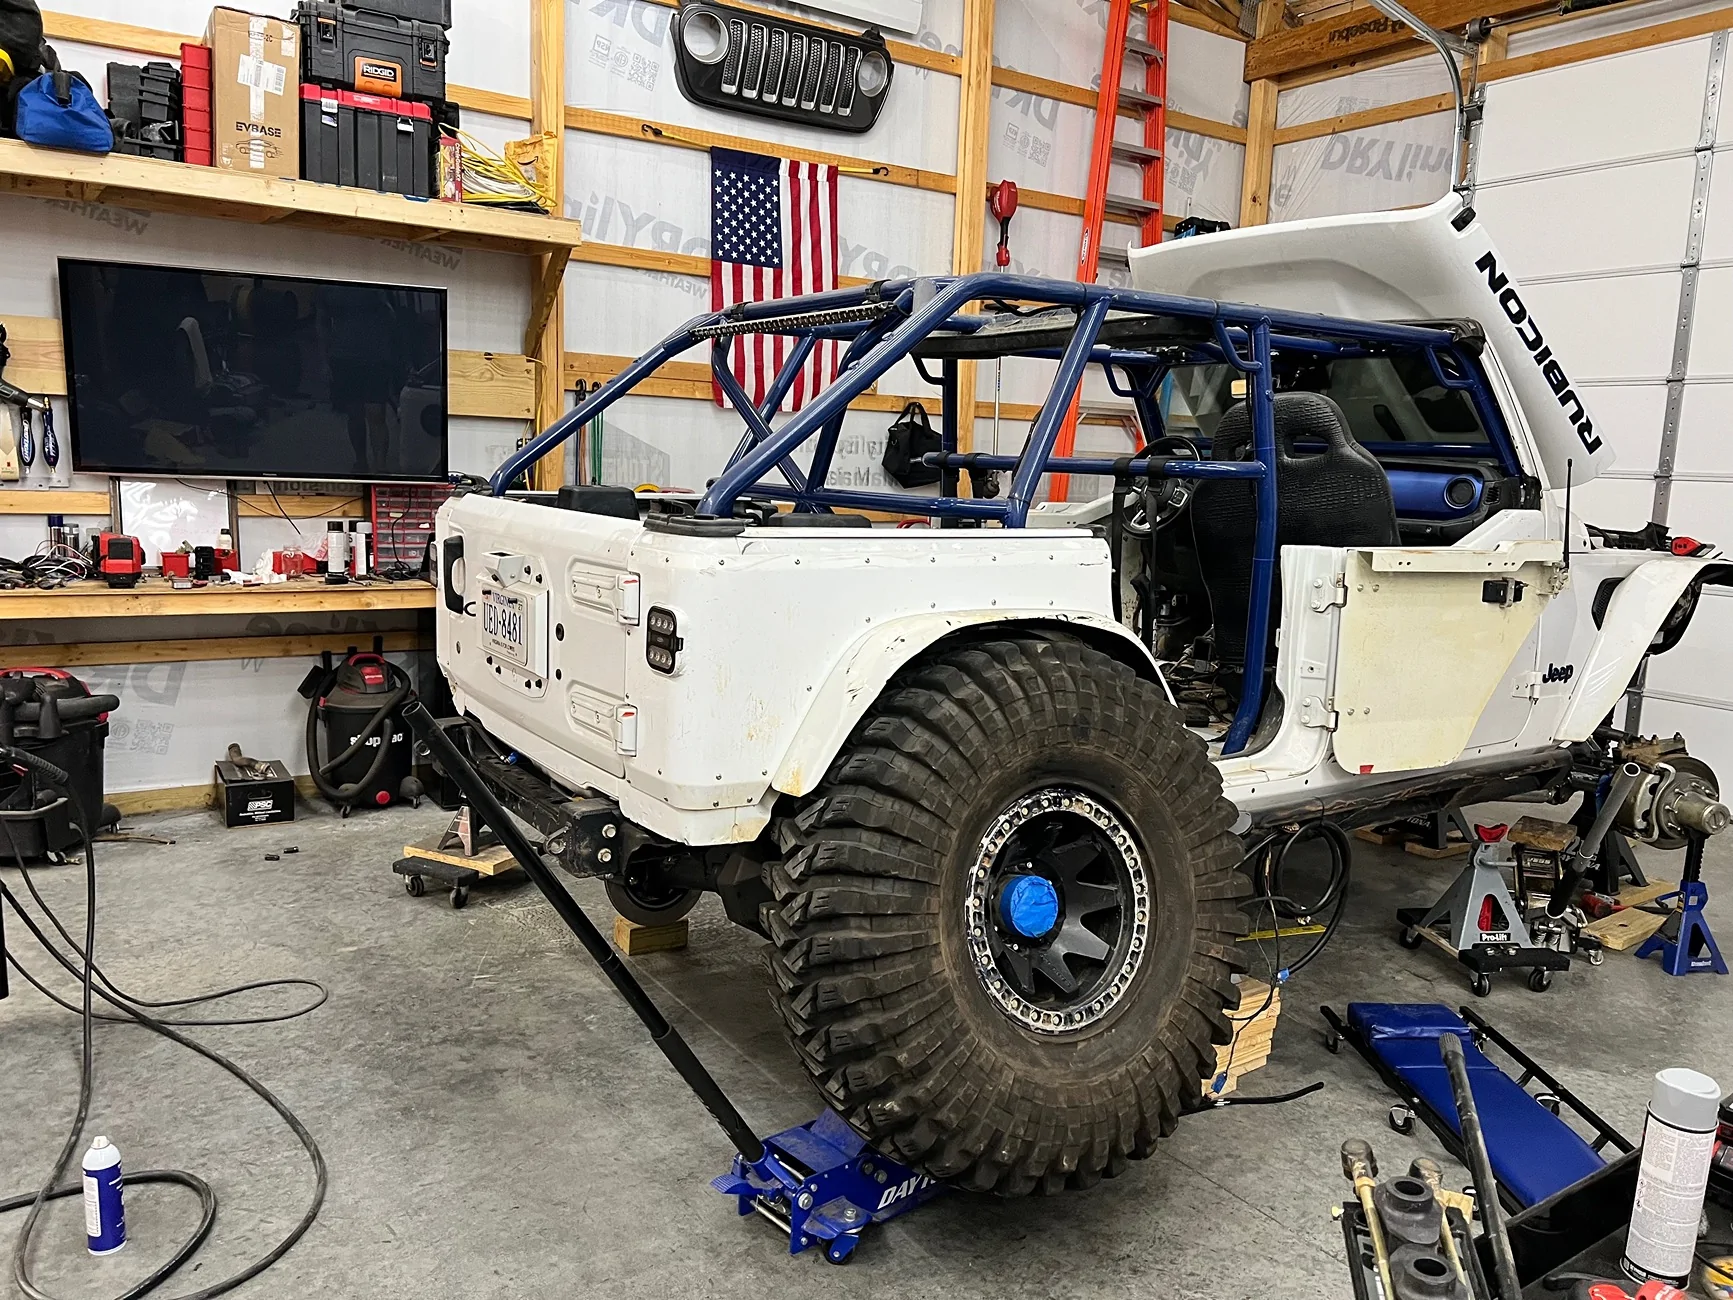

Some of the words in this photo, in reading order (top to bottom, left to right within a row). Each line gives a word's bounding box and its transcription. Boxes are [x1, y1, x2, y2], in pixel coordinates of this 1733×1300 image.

[363, 64, 394, 79] RIDGID
[235, 121, 282, 138] EVBASE
[1475, 251, 1603, 455] RUBICON
[1542, 663, 1573, 684] Jeep
[877, 1174, 937, 1210] DAYT
